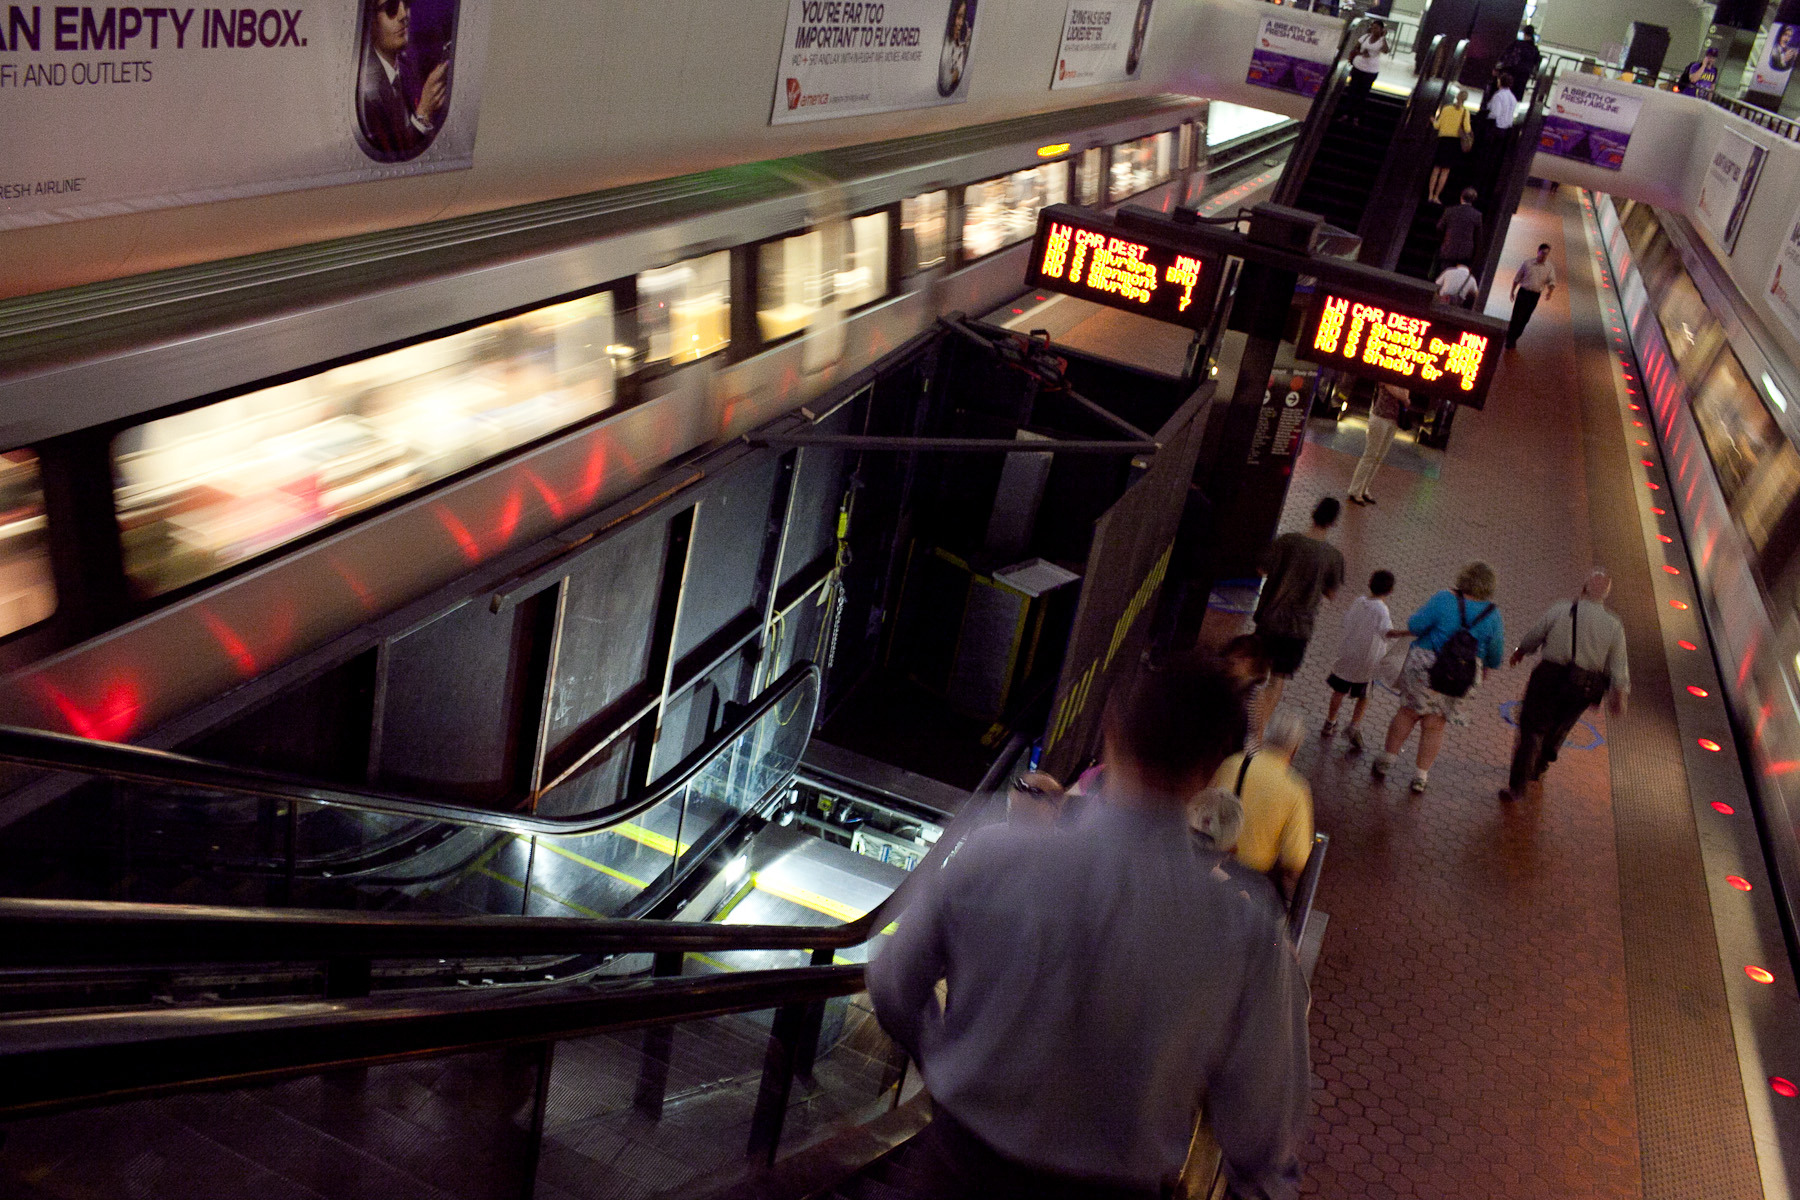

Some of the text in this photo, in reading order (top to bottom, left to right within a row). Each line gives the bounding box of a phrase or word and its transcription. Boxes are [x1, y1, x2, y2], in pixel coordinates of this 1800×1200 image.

[0, 6, 308, 51] N EMPTY INBOX.
[802, 1, 885, 24] YOU'RE FAR TOO
[1274, 21, 1304, 33] BREATH
[1305, 28, 1316, 36] OF
[795, 26, 860, 49] IMPORTANT
[860, 26, 874, 48] TO
[874, 26, 891, 47] FLY
[1265, 27, 1320, 46] FRESH AIRLINE
[24, 63, 66, 87] AND
[72, 61, 153, 85] OUTLETS
[1571, 88, 1603, 100] BREATH
[1604, 95, 1617, 103] OF
[1561, 92, 1619, 113] FRESH AIRLINE
[1048, 235, 1069, 252] RD
[1092, 248, 1156, 278] SilvrSpg
[1166, 266, 1198, 287] BRD
[1051, 223, 1201, 274] LN CAR DEST MIN
[1042, 260, 1063, 278] RD
[1087, 272, 1152, 303] SilvrSpg
[1179, 296, 1191, 311] 7
[1045, 248, 1066, 265] RD
[1090, 260, 1157, 290] Glenmont
[1185, 285, 1192, 298] 1
[1321, 308, 1345, 327] RD
[1369, 321, 1424, 350] Shady
[1429, 338, 1450, 355] Gr
[1448, 343, 1484, 364] BRD
[1326, 296, 1487, 351] LN CAR DEST MIN
[1314, 335, 1337, 353] RD
[1363, 348, 1416, 375] Shady
[1421, 363, 1442, 381] Gr
[1318, 322, 1341, 340] RD
[1366, 335, 1438, 367] Grsvnor
[1444, 356, 1479, 379] ARR
